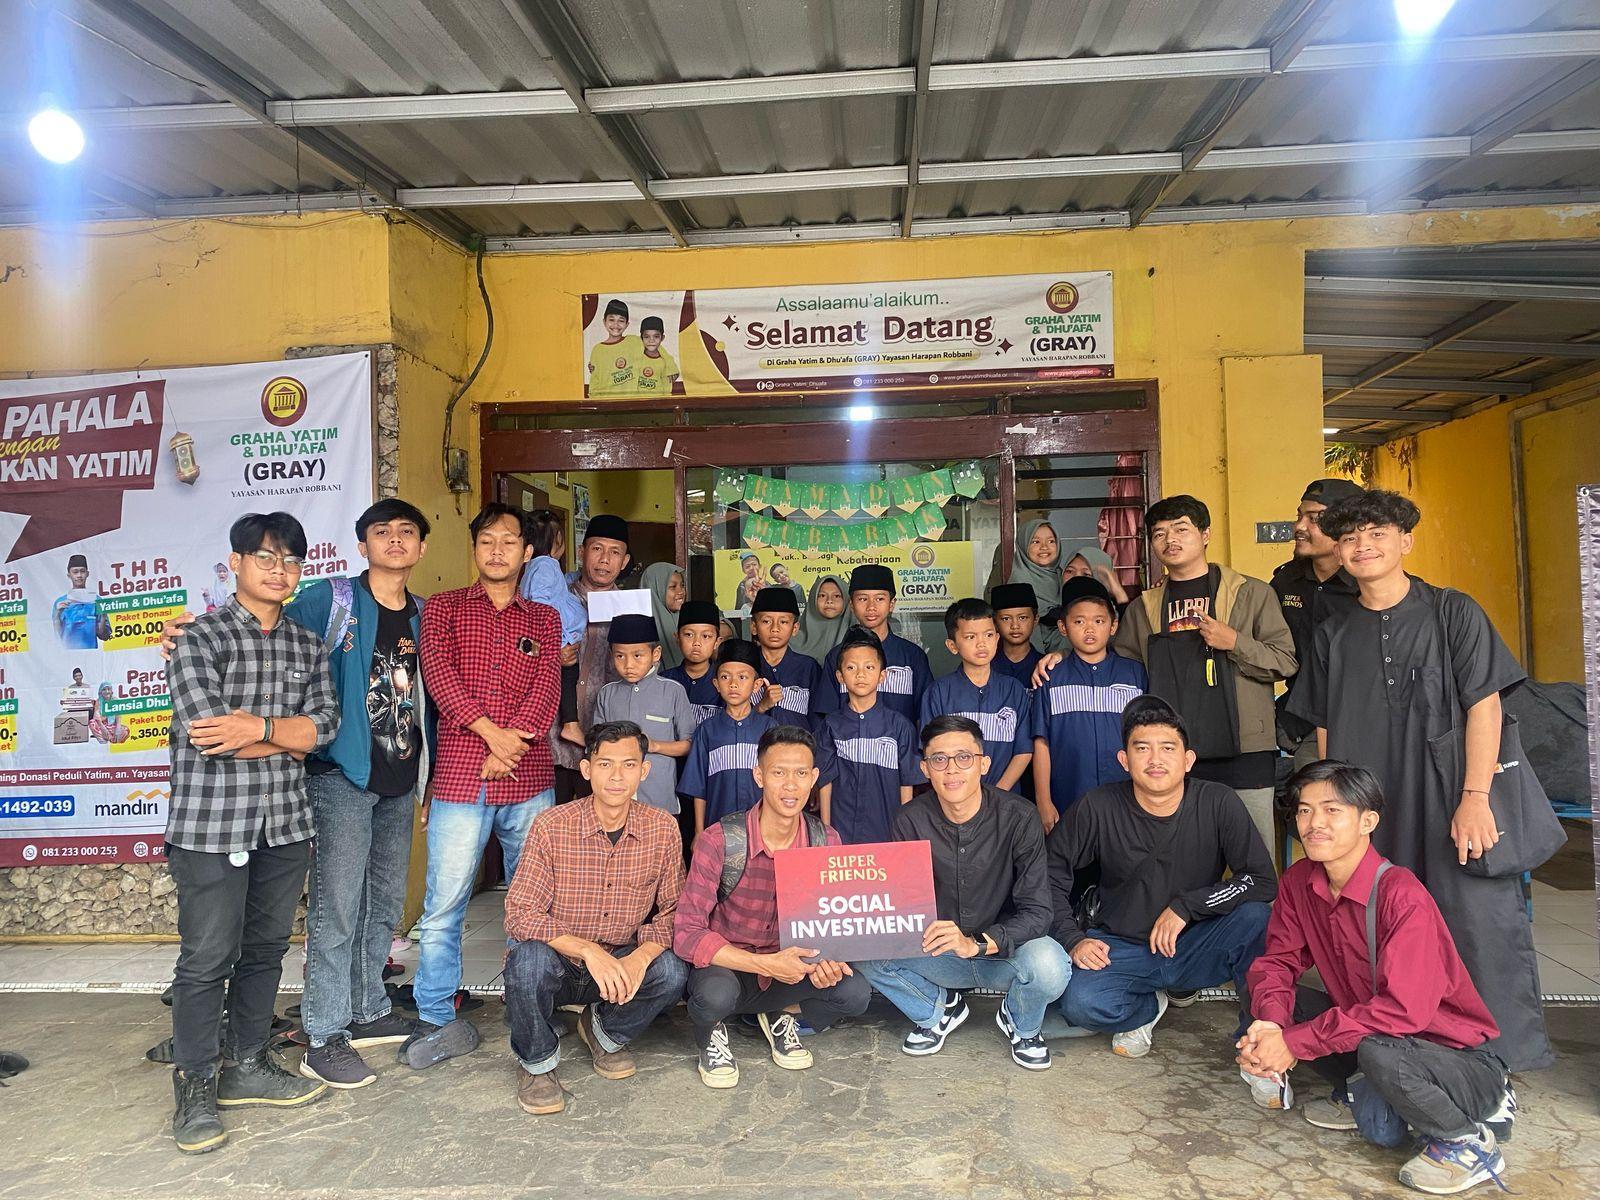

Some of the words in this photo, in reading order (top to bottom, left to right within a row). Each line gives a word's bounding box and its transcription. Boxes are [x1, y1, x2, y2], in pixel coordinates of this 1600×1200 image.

[1025, 316, 1064, 325] GRAHA
[1067, 314, 1101, 324] YATIM
[746, 319, 867, 347] Selamat
[883, 314, 993, 343] Datang
[1032, 326, 1041, 335] &
[1046, 324, 1094, 334] DHU'AFA
[1029, 335, 1097, 356] (GRAY)
[766, 358, 775, 366] Di
[776, 358, 797, 366] Graha
[798, 357, 818, 366] Yatim
[826, 356, 853, 364] Dhu'afa
[854, 354, 880, 364] (GRAY)
[882, 354, 910, 363] Yayasan
[911, 352, 942, 361] Harapan
[943, 350, 973, 359] Robbani
[2, 390, 153, 440] PAHALA
[230, 431, 287, 446] GRAHA
[291, 427, 338, 442] YATIM
[243, 446, 254, 458] &
[260, 441, 327, 457] DHU'AFA
[66, 449, 153, 479] YATIM
[244, 458, 326, 486] (GRAY)
[231, 489, 265, 498] YAYASAN
[267, 486, 304, 496] HARAPAN
[305, 484, 342, 493] ROBBANI
[307, 542, 337, 560] dik
[302, 559, 348, 577] aran
[802, 565, 831, 573] dengan
[98, 575, 182, 596] Lebaran
[912, 575, 945, 583] DHU'AFA
[901, 583, 948, 597] (GRAY)
[99, 600, 129, 611] Yatim
[132, 598, 140, 608] &
[143, 594, 184, 606] Dhu'afa
[115, 613, 140, 622] Paket
[142, 608, 172, 619] Donasi
[126, 669, 166, 684] Parc
[118, 682, 168, 698] Lebar
[104, 700, 143, 713] Lansia
[146, 696, 171, 708] Dhu'
[130, 715, 154, 725] Paket
[19, 771, 50, 782] Donasi
[53, 770, 82, 781] Peduli
[84, 769, 113, 780] Yatim,
[115, 771, 129, 779] an.
[131, 769, 170, 780] Yayasan
[94, 799, 158, 817] mandiri
[42, 848, 60, 857] 081
[61, 847, 79, 856] 233
[80, 847, 99, 856] 000
[100, 846, 118, 856] 253
[828, 854, 876, 869] SUPER
[820, 867, 887, 885] FRIENDS
[817, 893, 896, 916] SOCIAL
[790, 914, 926, 939] INVESTMENT
